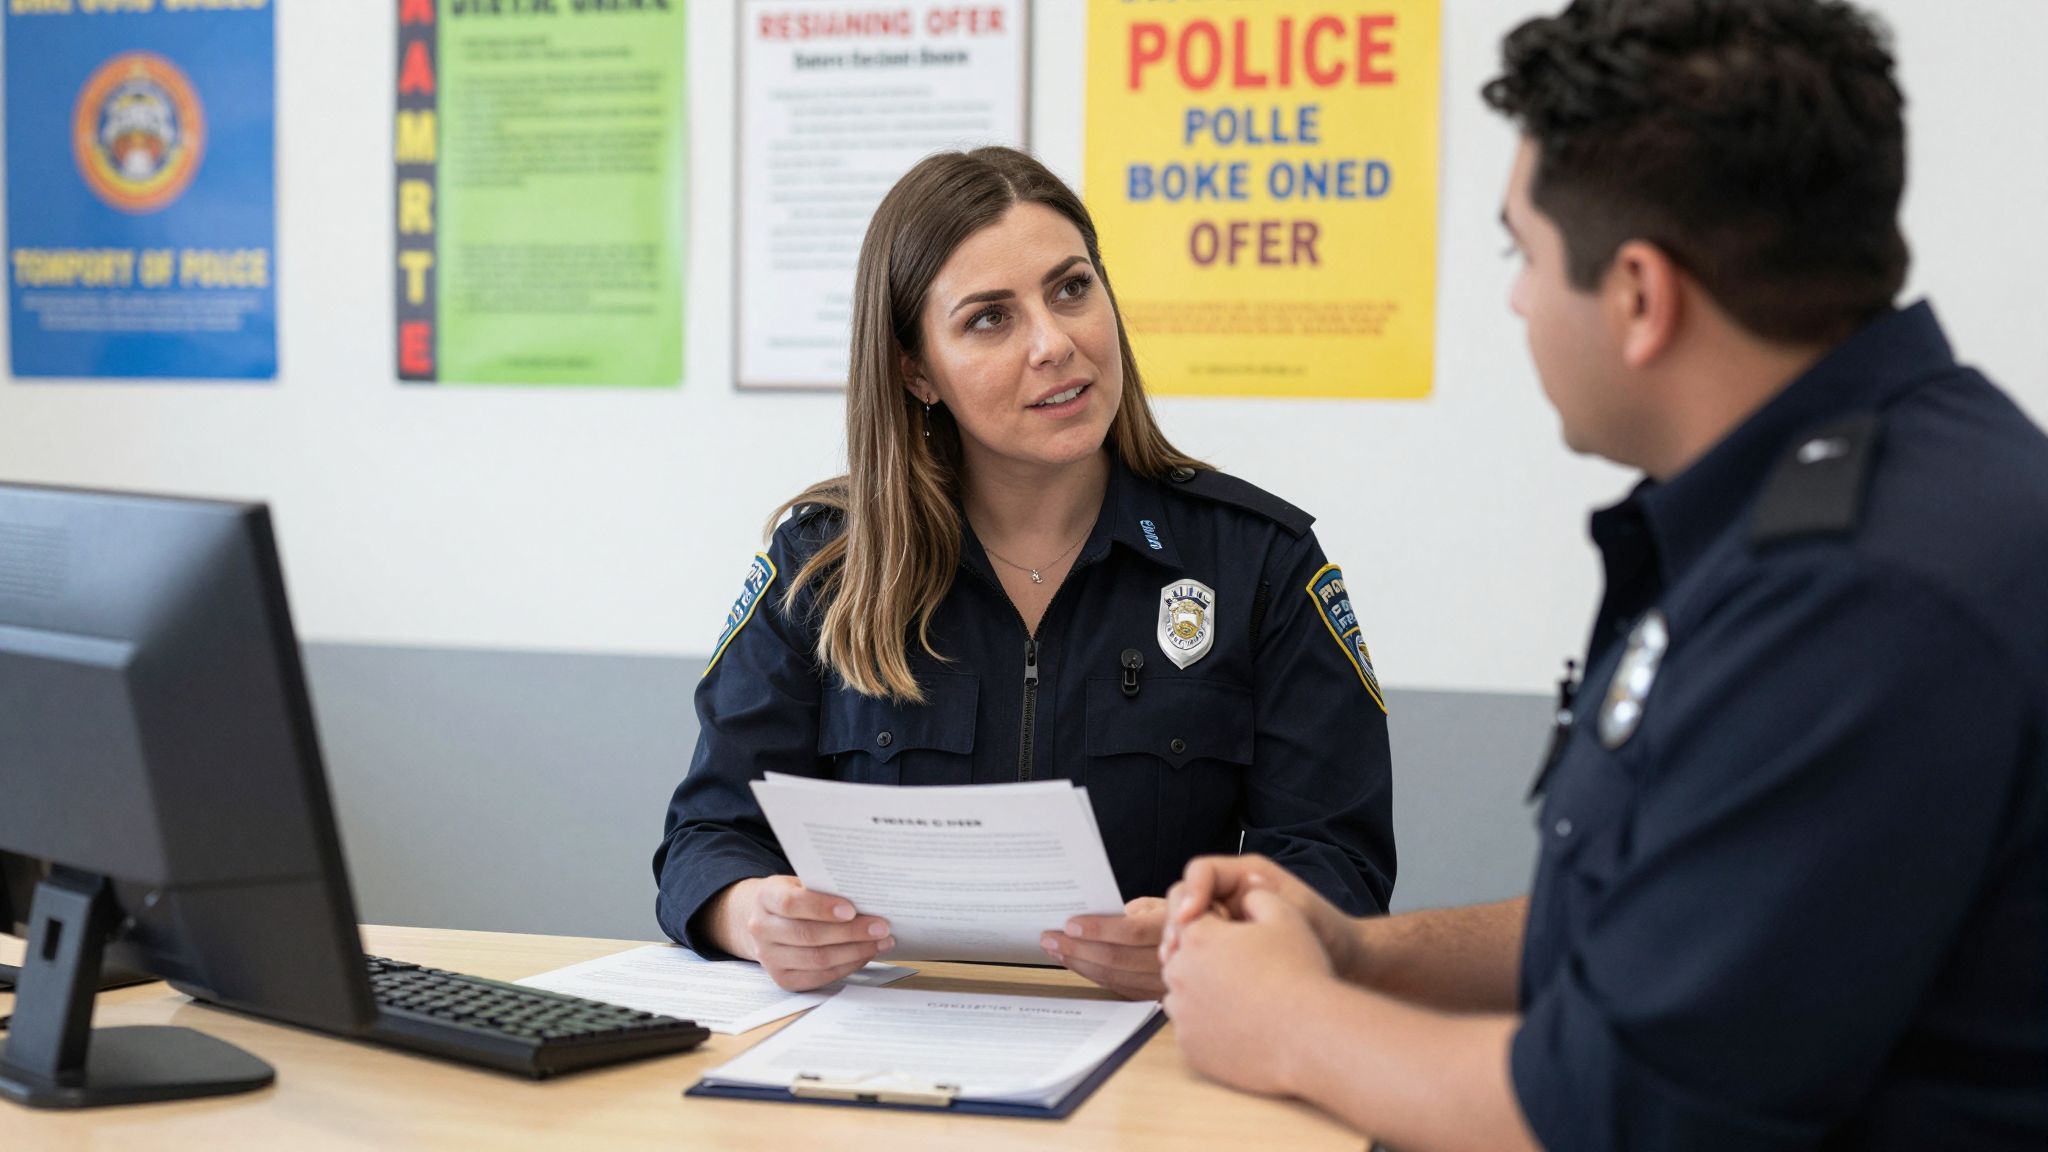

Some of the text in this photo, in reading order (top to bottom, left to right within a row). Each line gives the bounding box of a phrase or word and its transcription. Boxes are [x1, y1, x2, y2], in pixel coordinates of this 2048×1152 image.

[1127, 15, 1396, 91] POLICE
[1184, 106, 1321, 146] POLLE
[1126, 160, 1392, 201] BOKE ONED
[1188, 220, 1321, 267] OFER
